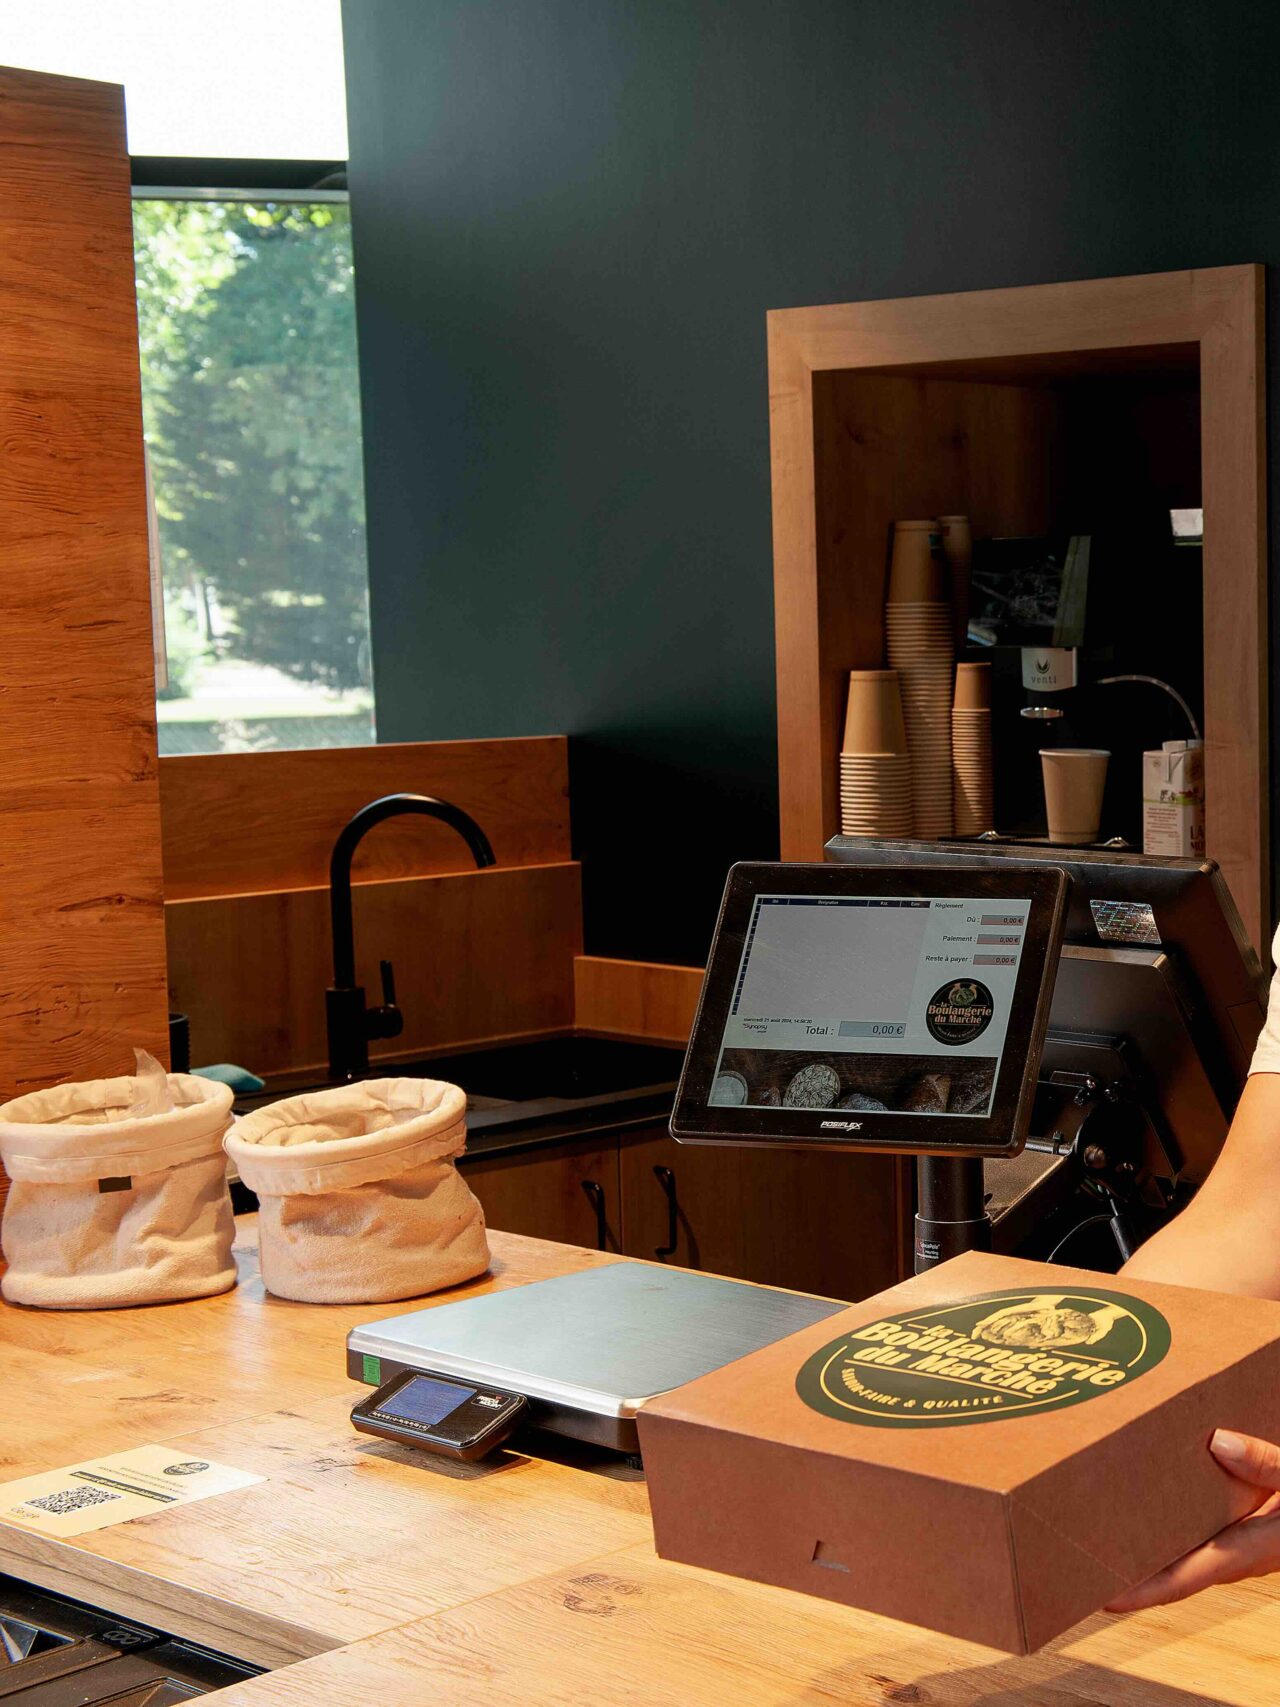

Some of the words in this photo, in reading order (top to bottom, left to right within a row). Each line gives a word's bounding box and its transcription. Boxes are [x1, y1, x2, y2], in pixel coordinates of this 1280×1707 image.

[928, 1005, 992, 1017] Boulangerie
[934, 1015, 946, 1023] du
[948, 1015, 982, 1024] Marché
[805, 1026, 828, 1035] Total
[872, 1025, 894, 1035] 0,00
[896, 1026, 903, 1034] €
[820, 1120, 864, 1131] POSIFLEX
[922, 1324, 954, 1338] la
[851, 1321, 1126, 1386] Boulangerie
[853, 1345, 912, 1366] du
[907, 1353, 1065, 1394] Marché
[902, 1399, 917, 1408] &
[922, 1395, 1004, 1410] QUALITÉ
